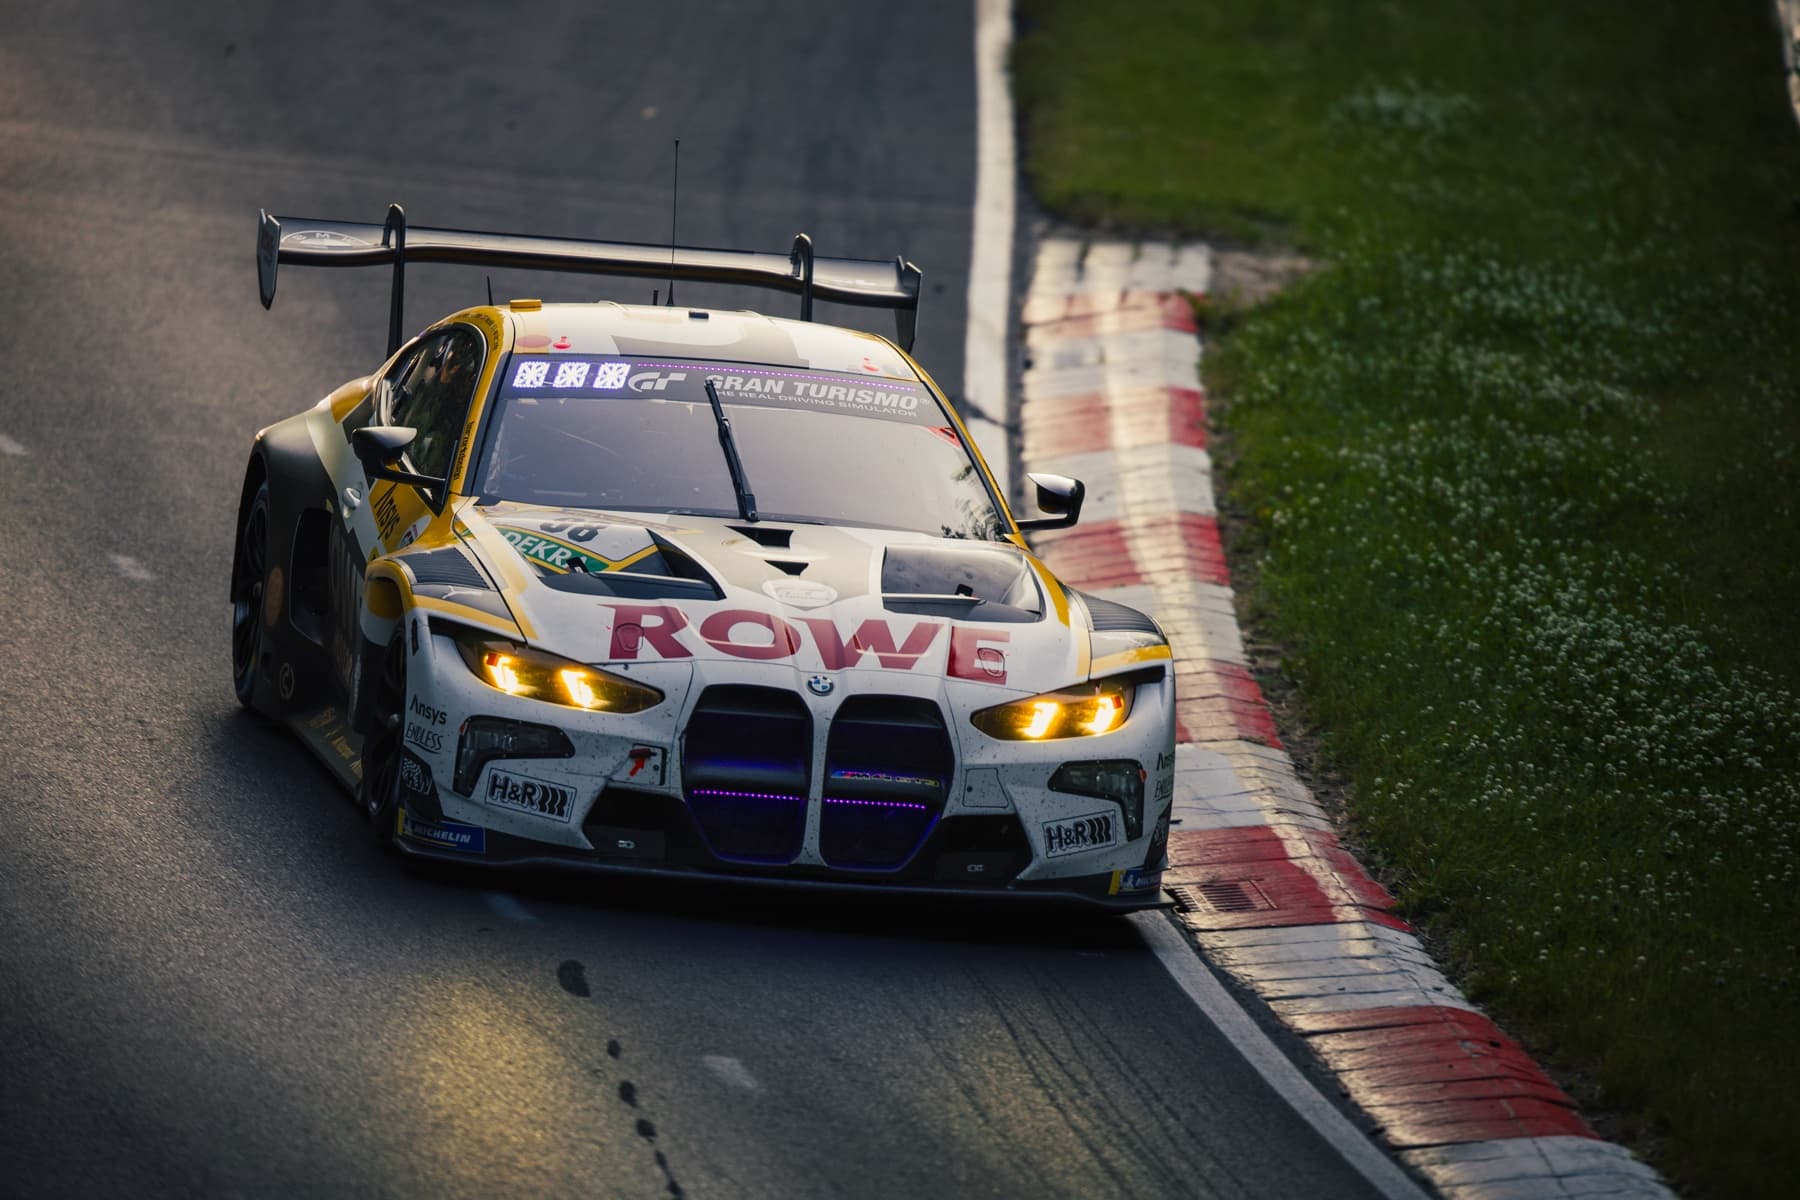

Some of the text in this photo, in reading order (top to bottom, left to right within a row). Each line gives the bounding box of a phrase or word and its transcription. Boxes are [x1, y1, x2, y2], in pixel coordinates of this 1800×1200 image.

[703, 375, 918, 410] GRAN TURISMO
[740, 391, 773, 400] REAL
[779, 395, 834, 406] DRIVING
[839, 403, 917, 417] SIMULATOR
[600, 604, 1010, 685] ROWE
[409, 694, 447, 726] Ansys
[405, 722, 444, 752] ENDLESS
[490, 773, 537, 805] H&R
[1045, 820, 1088, 851] H&R
